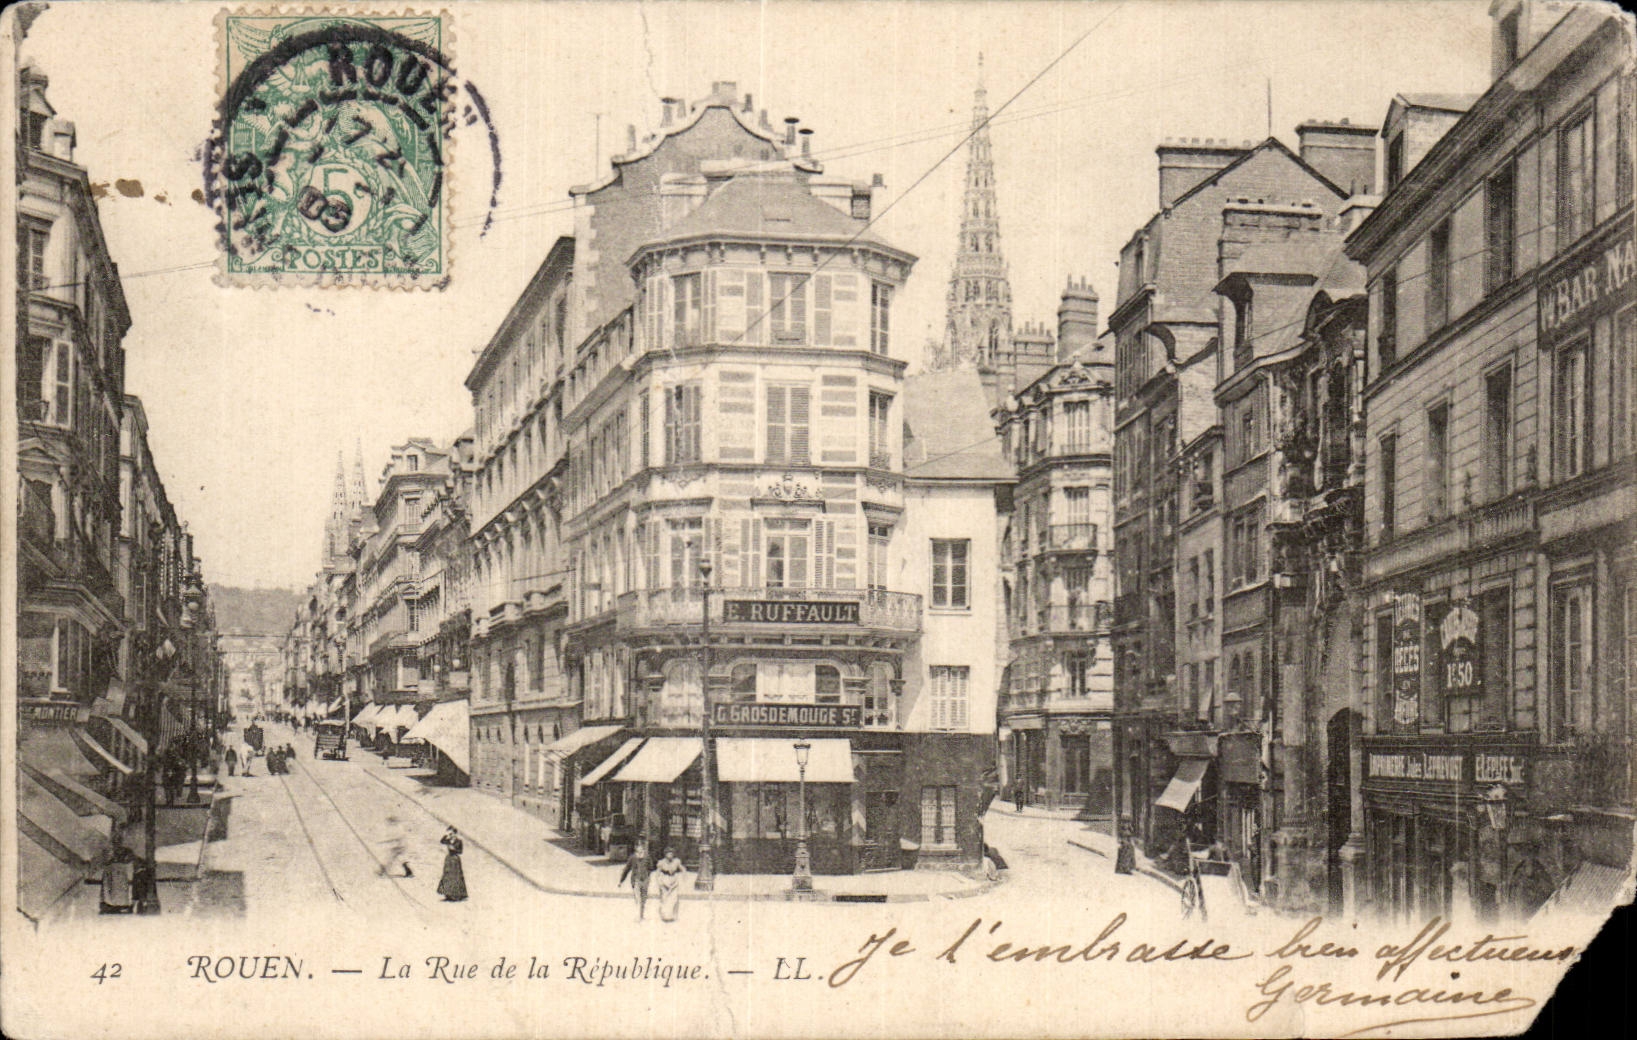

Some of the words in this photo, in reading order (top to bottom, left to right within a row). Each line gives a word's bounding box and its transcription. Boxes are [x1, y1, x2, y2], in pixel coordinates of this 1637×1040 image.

[288, 250, 380, 269] POSTES
[752, 603, 858, 623] RUFFAULT
[730, 705, 838, 725] GROSDEMOUGE
[828, 927, 916, 989] Je
[1265, 916, 1359, 960] bien
[1246, 965, 1536, 1023] Germaine
